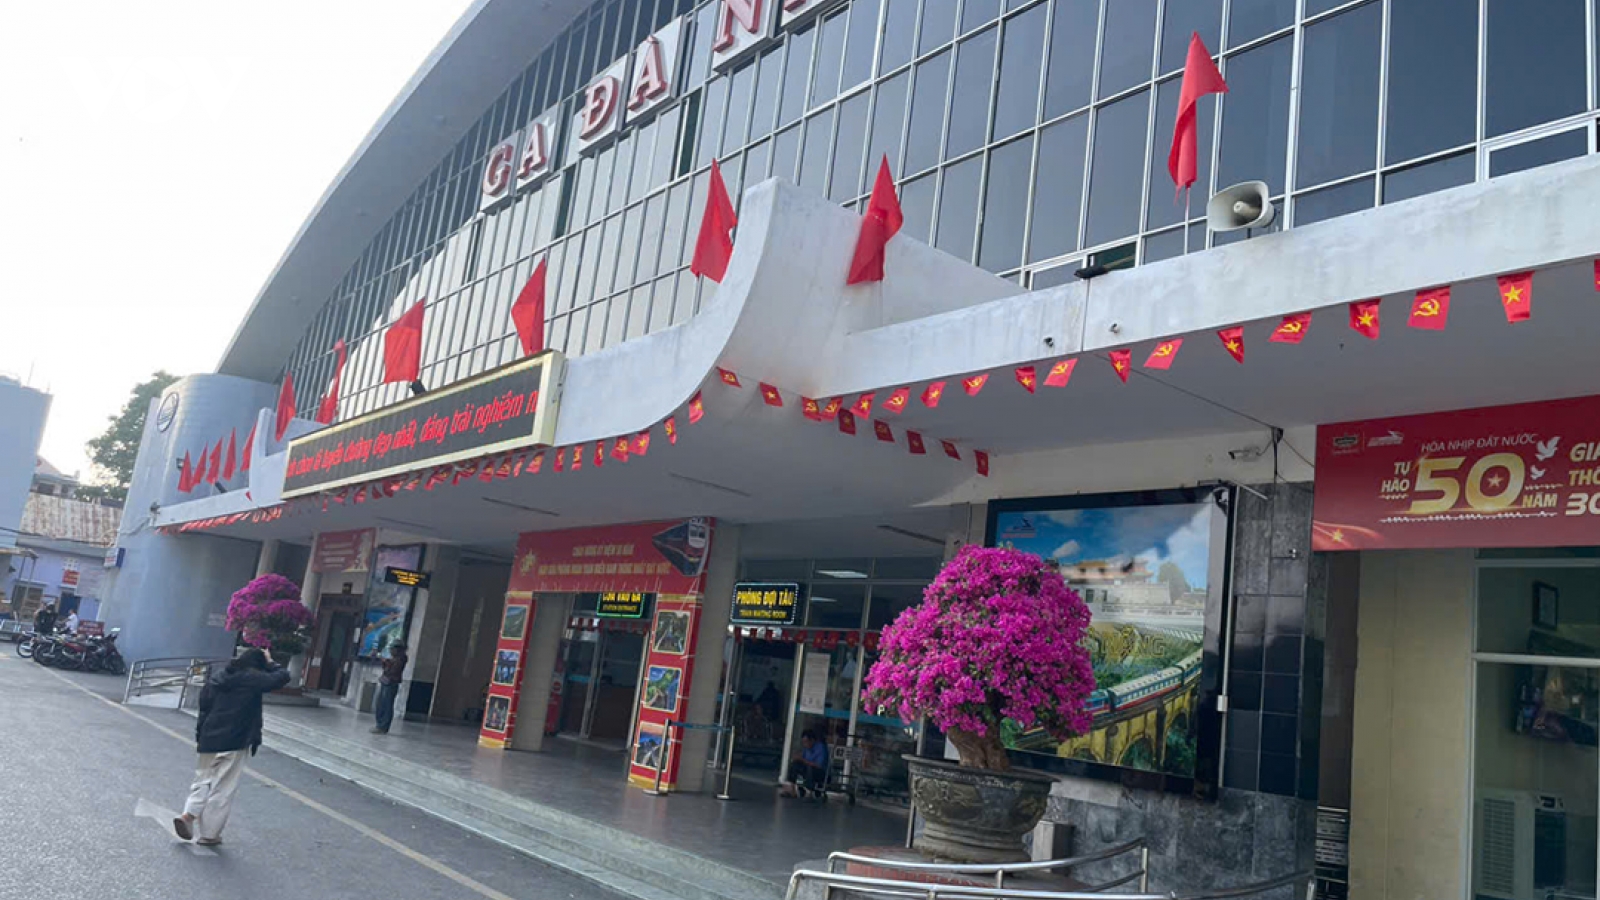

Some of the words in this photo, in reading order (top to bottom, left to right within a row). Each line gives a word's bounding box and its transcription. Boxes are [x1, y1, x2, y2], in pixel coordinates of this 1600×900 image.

[482, 122, 547, 198] GA
[580, 34, 667, 141] ĐÀ
[472, 390, 525, 433] nghiệm
[1421, 440, 1446, 453] HÒA
[1448, 438, 1474, 452] NHỊP
[1476, 434, 1500, 448] ĐẤT
[1501, 432, 1538, 446] NƯỚC
[1381, 477, 1411, 493] HÀO
[1408, 452, 1526, 515] 50
[1522, 491, 1558, 508] NĂM
[735, 587, 763, 605] PHÒNG
[778, 588, 795, 606] TÀU
